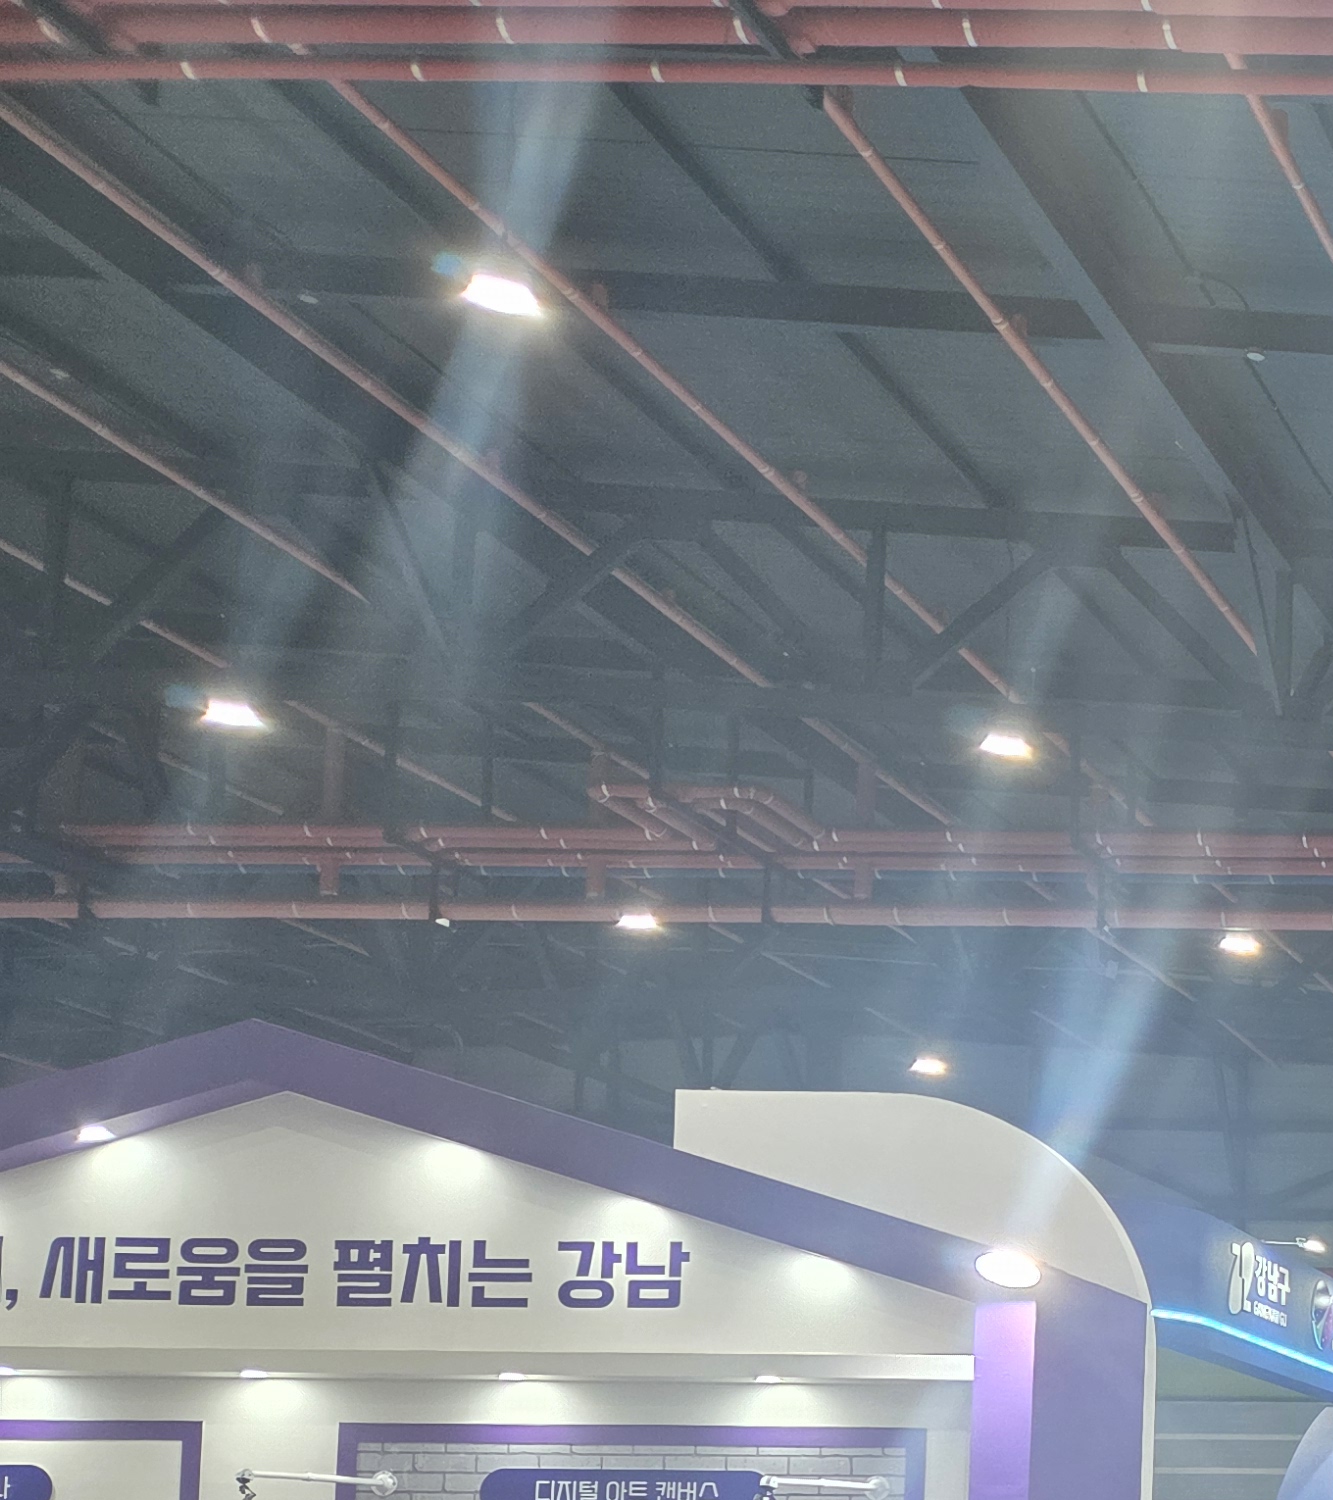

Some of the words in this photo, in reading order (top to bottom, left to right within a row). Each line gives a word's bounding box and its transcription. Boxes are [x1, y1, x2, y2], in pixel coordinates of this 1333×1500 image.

[39, 1236, 309, 1307] 새로움을
[333, 1236, 533, 1308] 펼치는
[557, 1241, 691, 1309] 강남
[1255, 1255, 1291, 1306] 강남구
